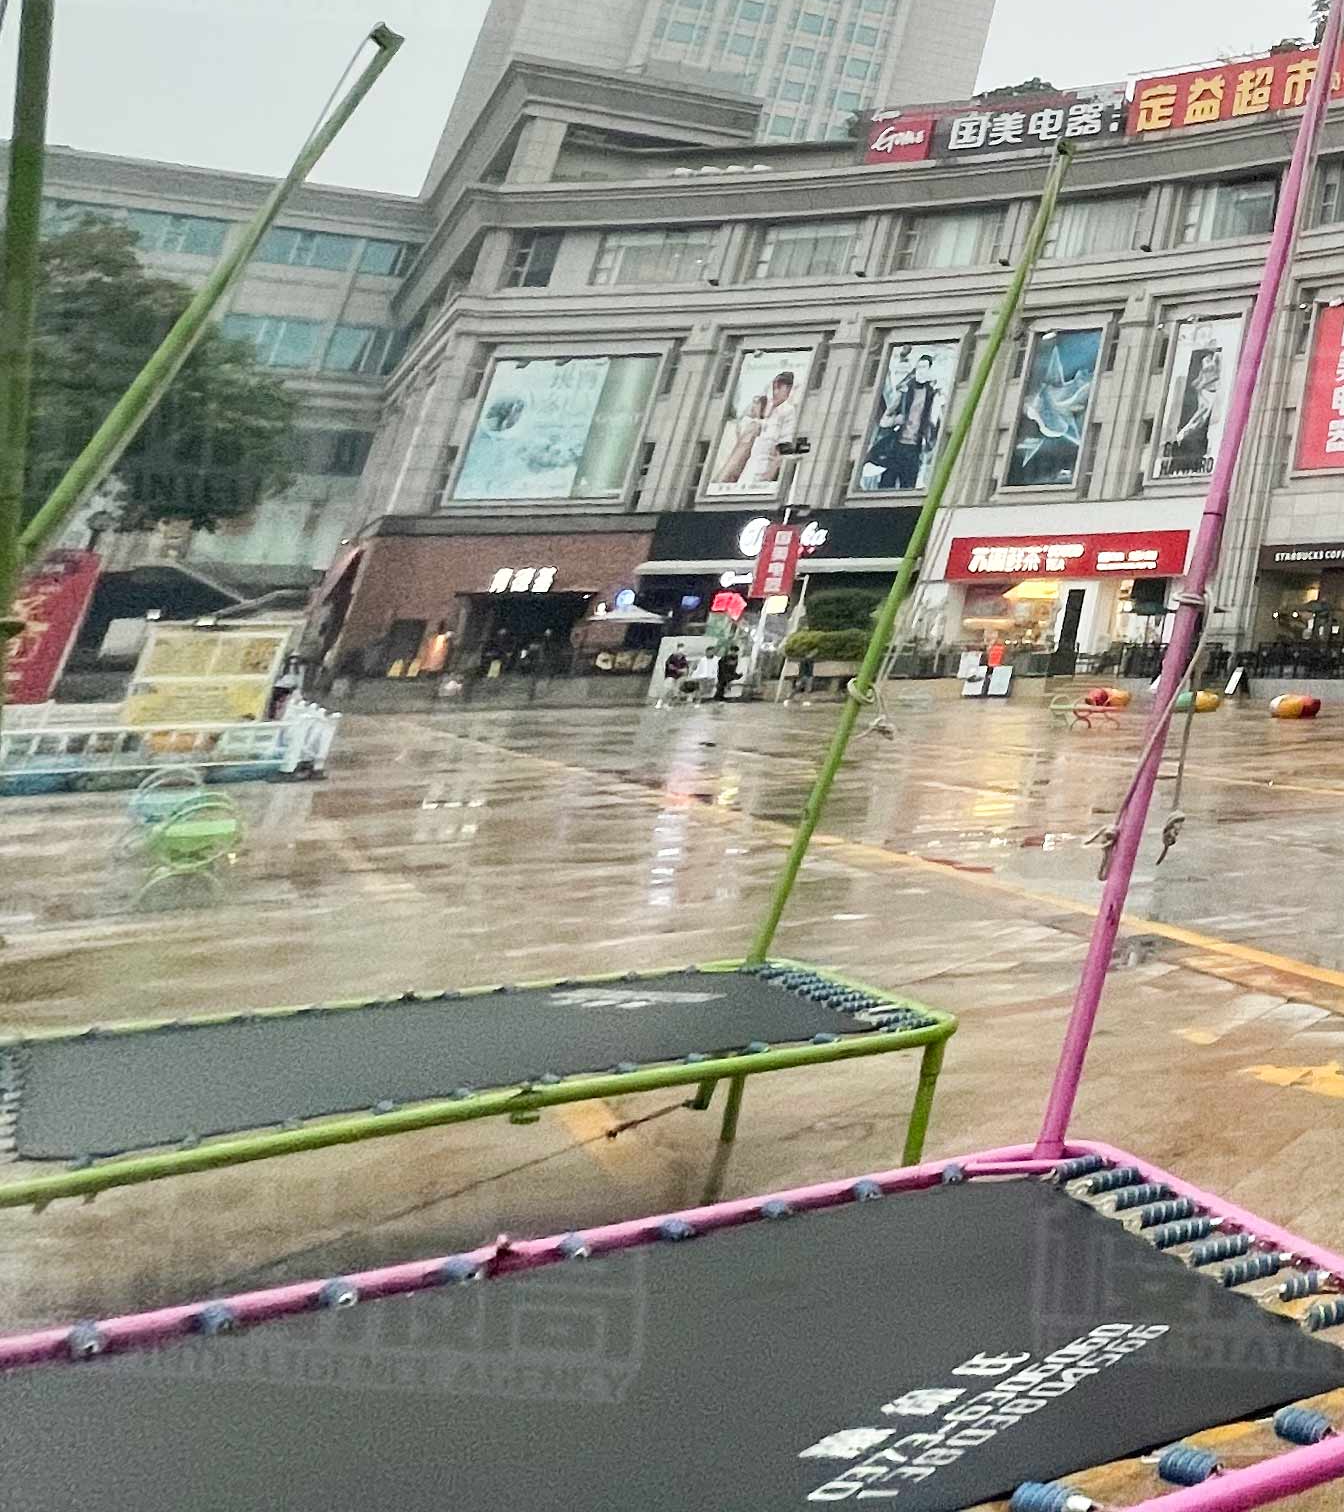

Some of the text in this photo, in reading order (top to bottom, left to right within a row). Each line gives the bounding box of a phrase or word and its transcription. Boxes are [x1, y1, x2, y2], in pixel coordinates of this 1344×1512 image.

[1136, 58, 1319, 132] 定益超市
[948, 103, 1104, 150] 国美电器
[1275, 551, 1323, 561] STARBUCKS
